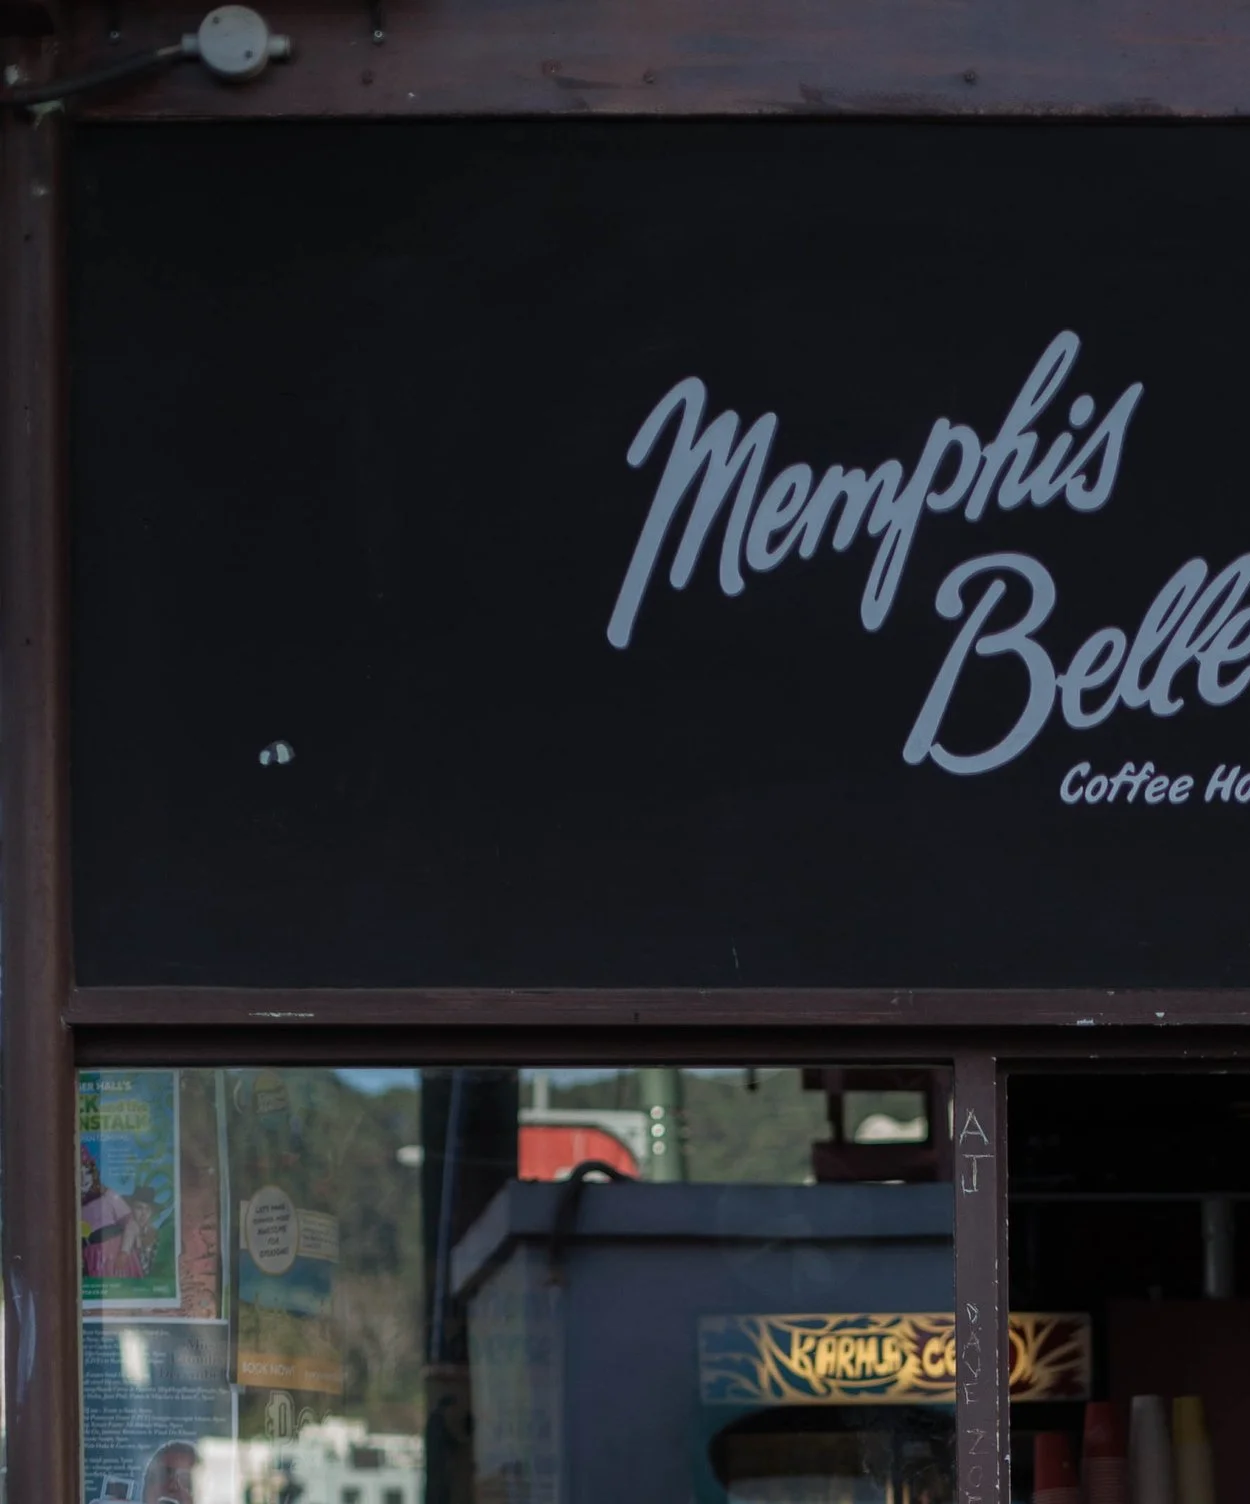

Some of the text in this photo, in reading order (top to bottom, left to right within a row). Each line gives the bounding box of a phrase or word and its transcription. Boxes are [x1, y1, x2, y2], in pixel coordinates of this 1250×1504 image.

[606, 329, 1144, 649] Memphis
[1059, 761, 1193, 804] Coffee
[791, 1331, 904, 1386] KARMA
